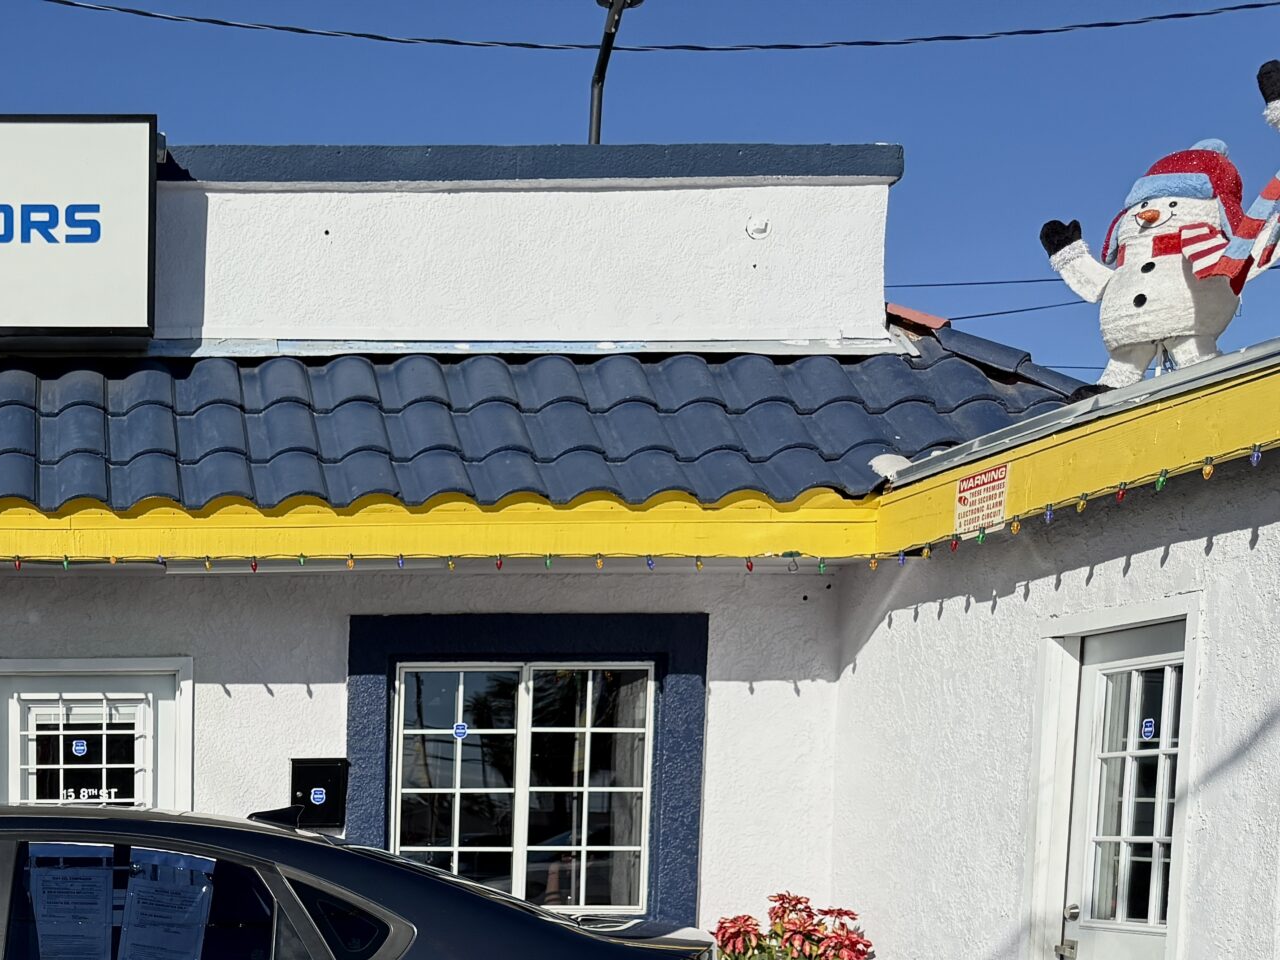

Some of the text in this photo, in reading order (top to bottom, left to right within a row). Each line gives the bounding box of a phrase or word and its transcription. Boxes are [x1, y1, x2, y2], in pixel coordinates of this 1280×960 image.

[960, 467, 1006, 492] WARNING
[969, 481, 1005, 499] THESE PREMISES
[969, 499, 977, 508] ARE
[978, 493, 998, 505] SECURED
[958, 500, 1003, 520] ELECTRONIC ALARM
[981, 509, 1001, 521] CIRCUIT
[79, 788, 98, 801] 8TH
[99, 788, 119, 801] ST
